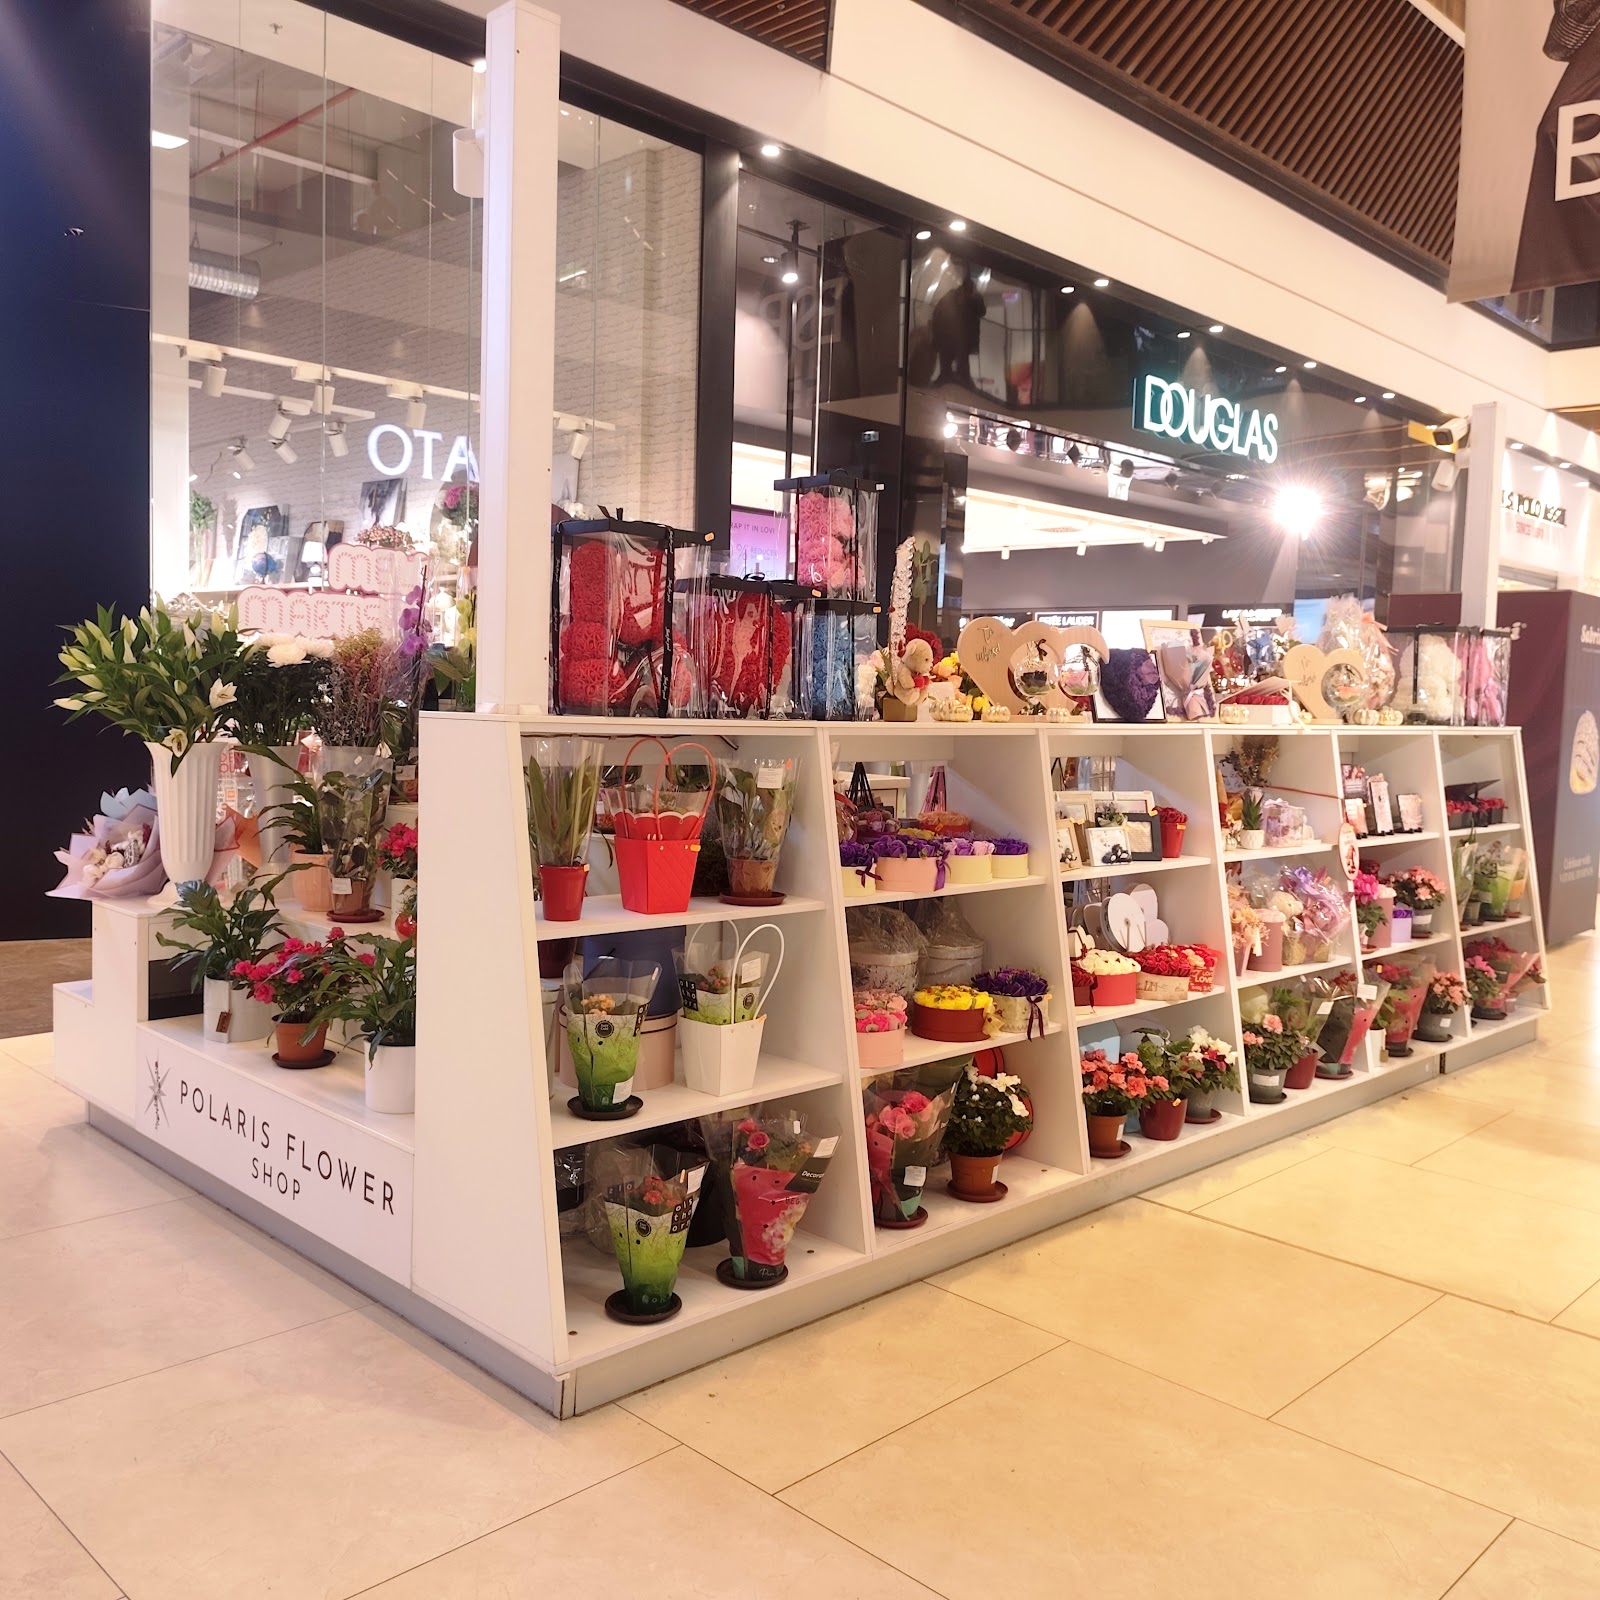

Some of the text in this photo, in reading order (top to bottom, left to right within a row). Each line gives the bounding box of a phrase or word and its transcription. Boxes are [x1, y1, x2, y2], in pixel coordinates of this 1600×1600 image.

[1143, 374, 1279, 464] DOUGLAS
[180, 1079, 271, 1149] POLARIS
[286, 1132, 395, 1216] FLOWER
[251, 1156, 301, 1201] SHOP
